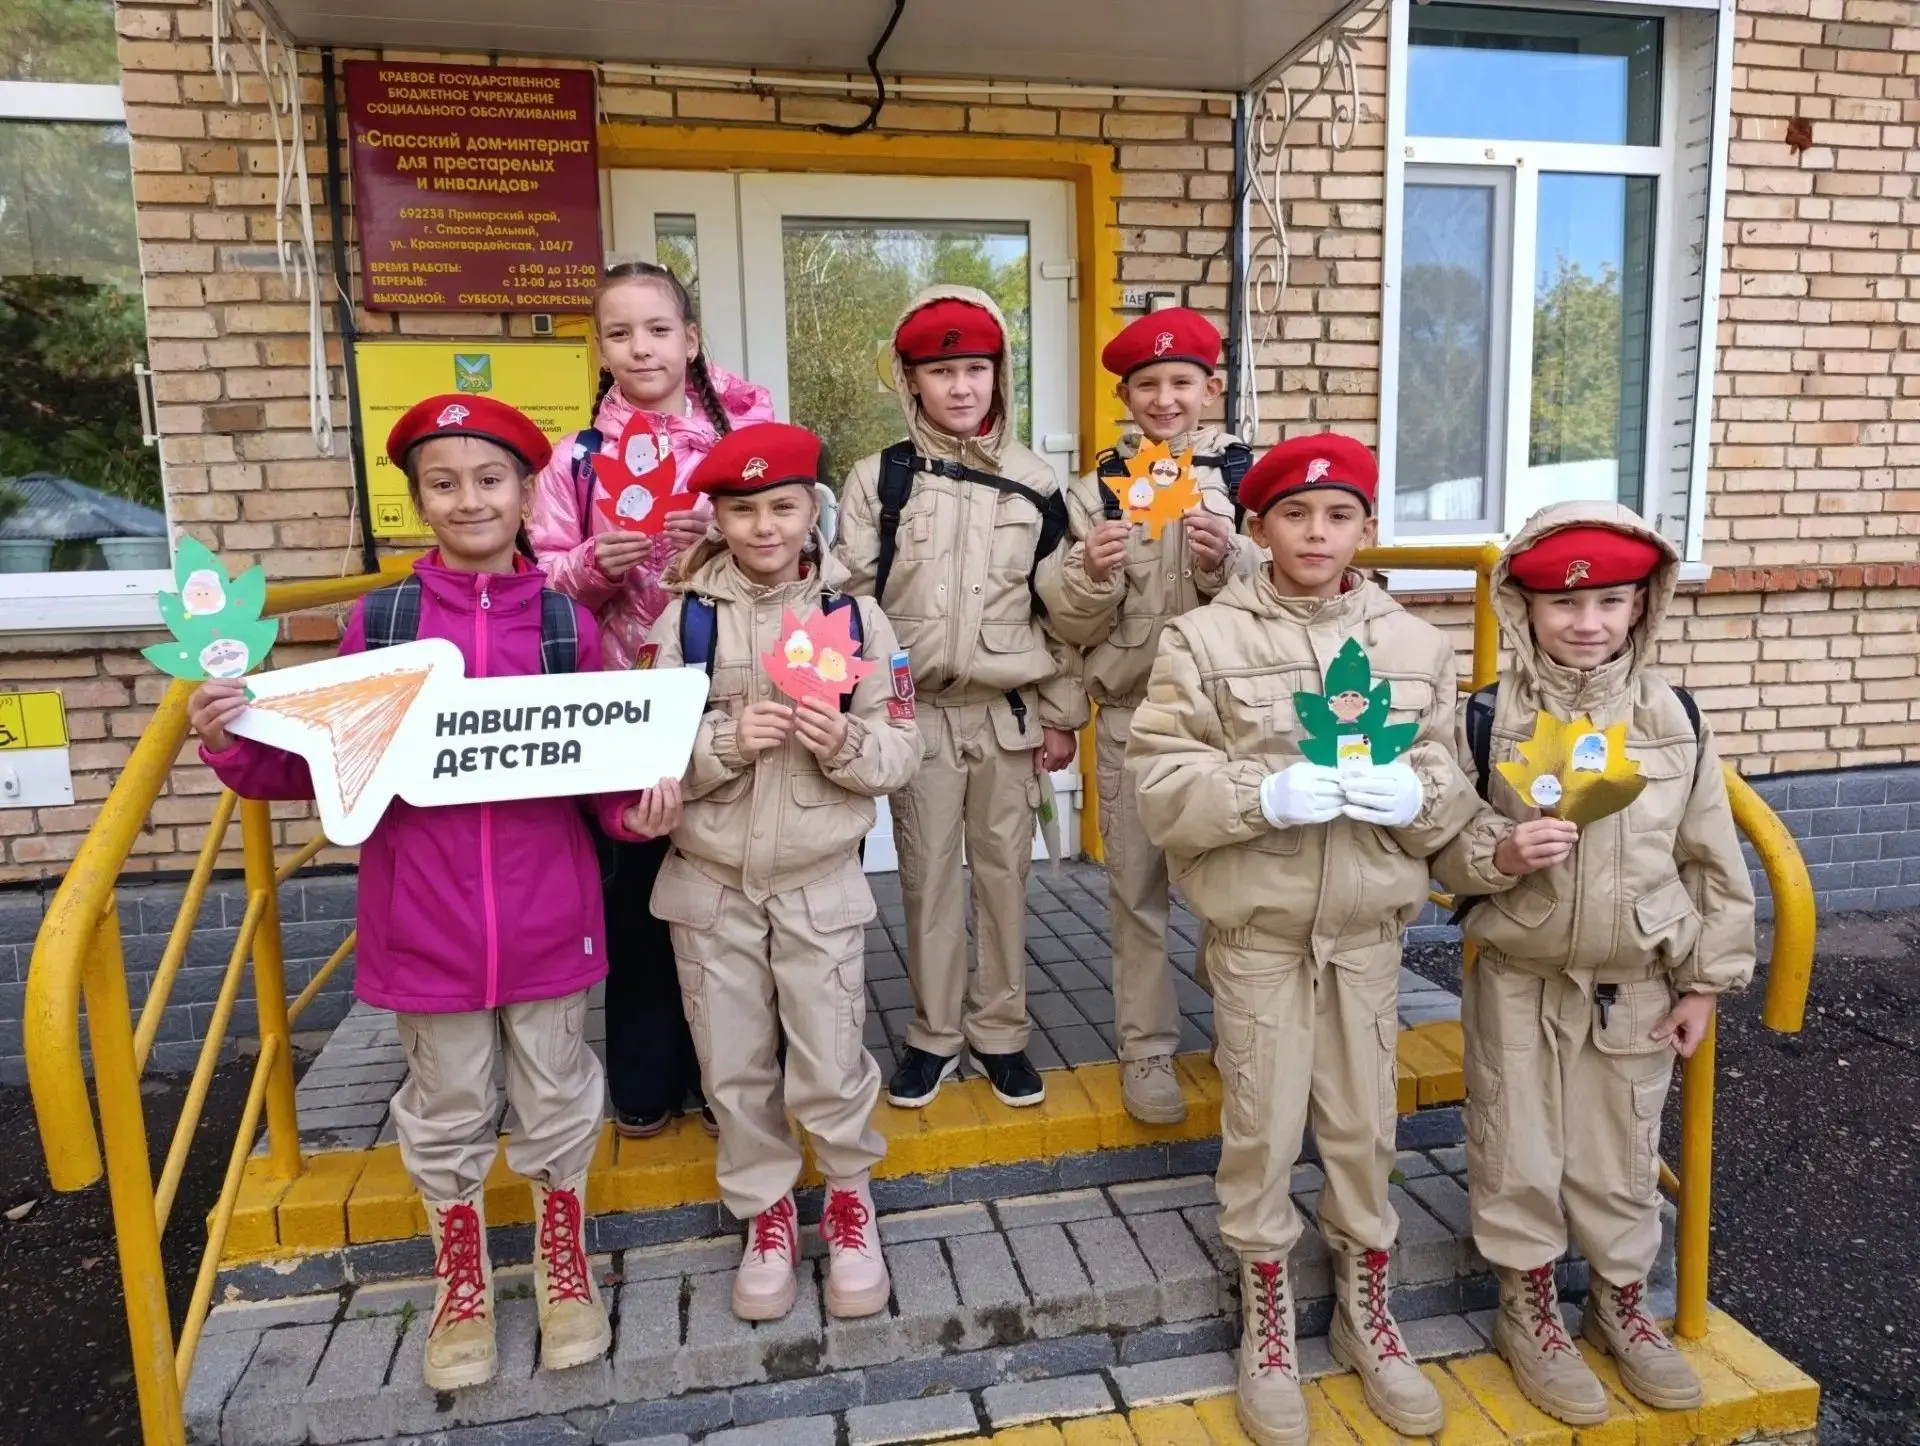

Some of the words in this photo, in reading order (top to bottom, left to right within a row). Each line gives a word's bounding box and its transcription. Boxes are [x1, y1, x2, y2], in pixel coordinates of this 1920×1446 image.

[379, 71, 436, 84] КРАЕВОЕ
[439, 73, 561, 89] ГОСУДАРСТВЕННОЕ
[388, 87, 469, 101] БЮДЖЕТНОЕ
[473, 91, 555, 105] УЧРЕЖДЕНИЕ
[366, 102, 466, 117] СОЦИАЛЬНОГО
[470, 106, 577, 121] ОБСЛУЖИВАНИЯ
[357, 129, 461, 149] «Спасский
[466, 137, 590, 156] дом-интернат
[396, 155, 428, 172] для
[433, 156, 555, 176] престарелых
[416, 176, 428, 190] и
[433, 176, 539, 194] инвалидов»
[448, 208, 525, 223] Приморский
[527, 210, 561, 224] край,
[436, 223, 539, 237] Спасск-Дальний,
[389, 239, 407, 252] ул.
[410, 237, 536, 253] Красногвардейская,
[539, 240, 574, 253] 104/7
[370, 262, 410, 274] ВРЕМЯ
[412, 262, 462, 273] РАБОТЫ:
[519, 264, 544, 274] 8-00
[547, 266, 561, 275] до
[565, 264, 596, 275] 17-00
[371, 276, 428, 287] ПЕРЕРЫВ:
[514, 277, 545, 288] 12-00
[548, 279, 563, 289] до
[566, 278, 597, 288] 13-00
[373, 291, 446, 305] ВЫХОДНОЙ:
[458, 293, 514, 306] СУББОТА,
[516, 295, 594, 305] ВОСКРЕСЕНЬ
[435, 699, 651, 737] НАВИГАТОРЫ
[433, 739, 582, 779] ДЕТСТВА
